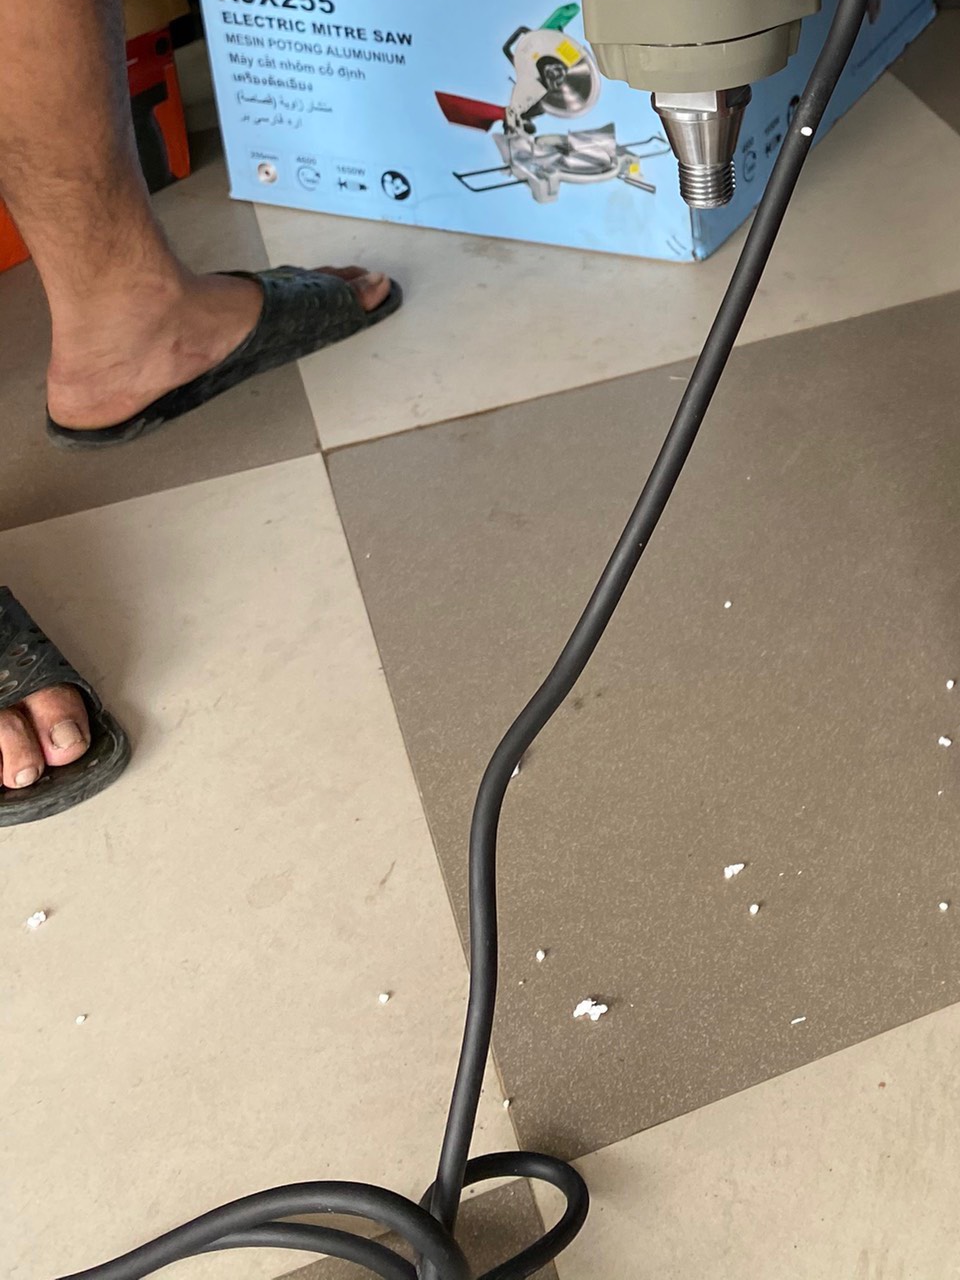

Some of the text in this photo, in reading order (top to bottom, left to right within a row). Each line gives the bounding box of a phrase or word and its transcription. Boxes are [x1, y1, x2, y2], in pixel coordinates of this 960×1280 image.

[222, 11, 412, 45] ELECTRIC MITRE SAW
[226, 33, 406, 65] MESIN POTONG ALUMUNIUM
[229, 53, 253, 68] Máy
[279, 59, 315, 74] nhôm
[337, 66, 366, 81] định
